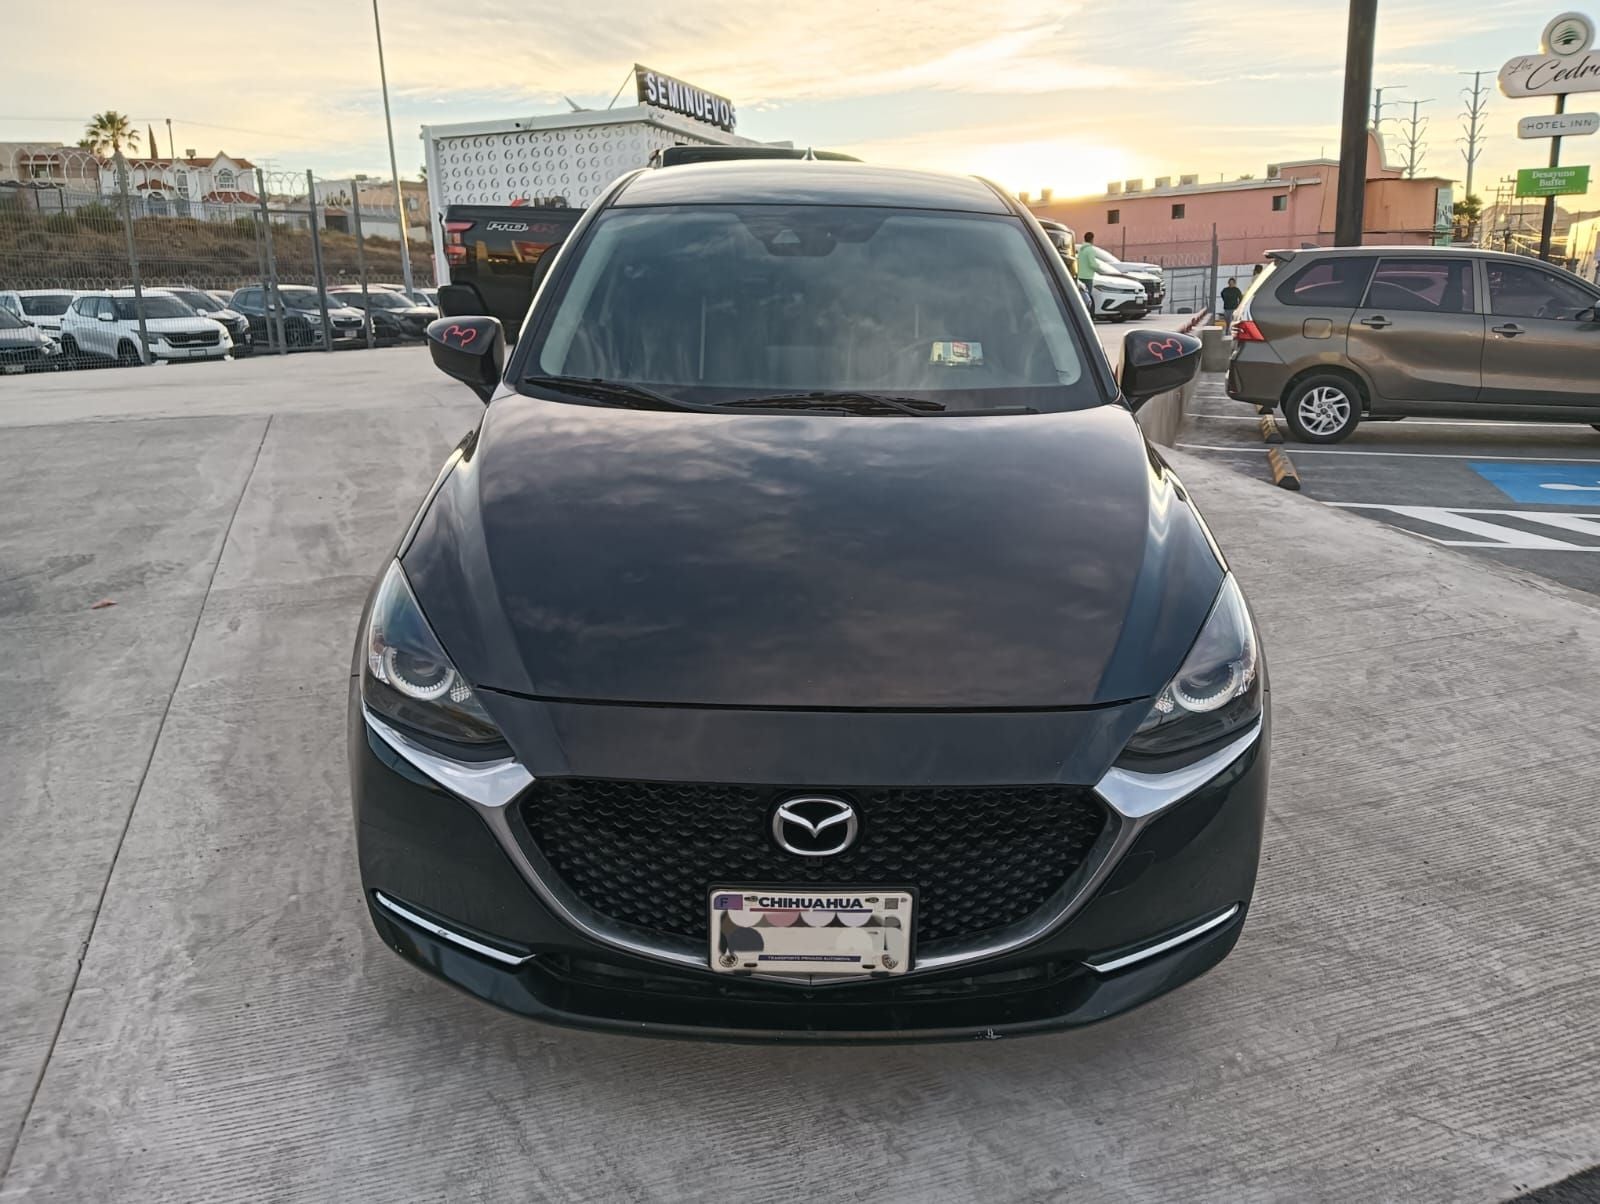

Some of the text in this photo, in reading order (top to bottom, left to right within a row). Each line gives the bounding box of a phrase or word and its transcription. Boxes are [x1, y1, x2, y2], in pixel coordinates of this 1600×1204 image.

[647, 72, 737, 128] SEMINUEVOS
[1527, 119, 1592, 130] HOTEL INN
[1532, 170, 1576, 180] Desayuno
[1540, 178, 1566, 186] Buffet
[759, 897, 863, 909] CHIHUAHUA
